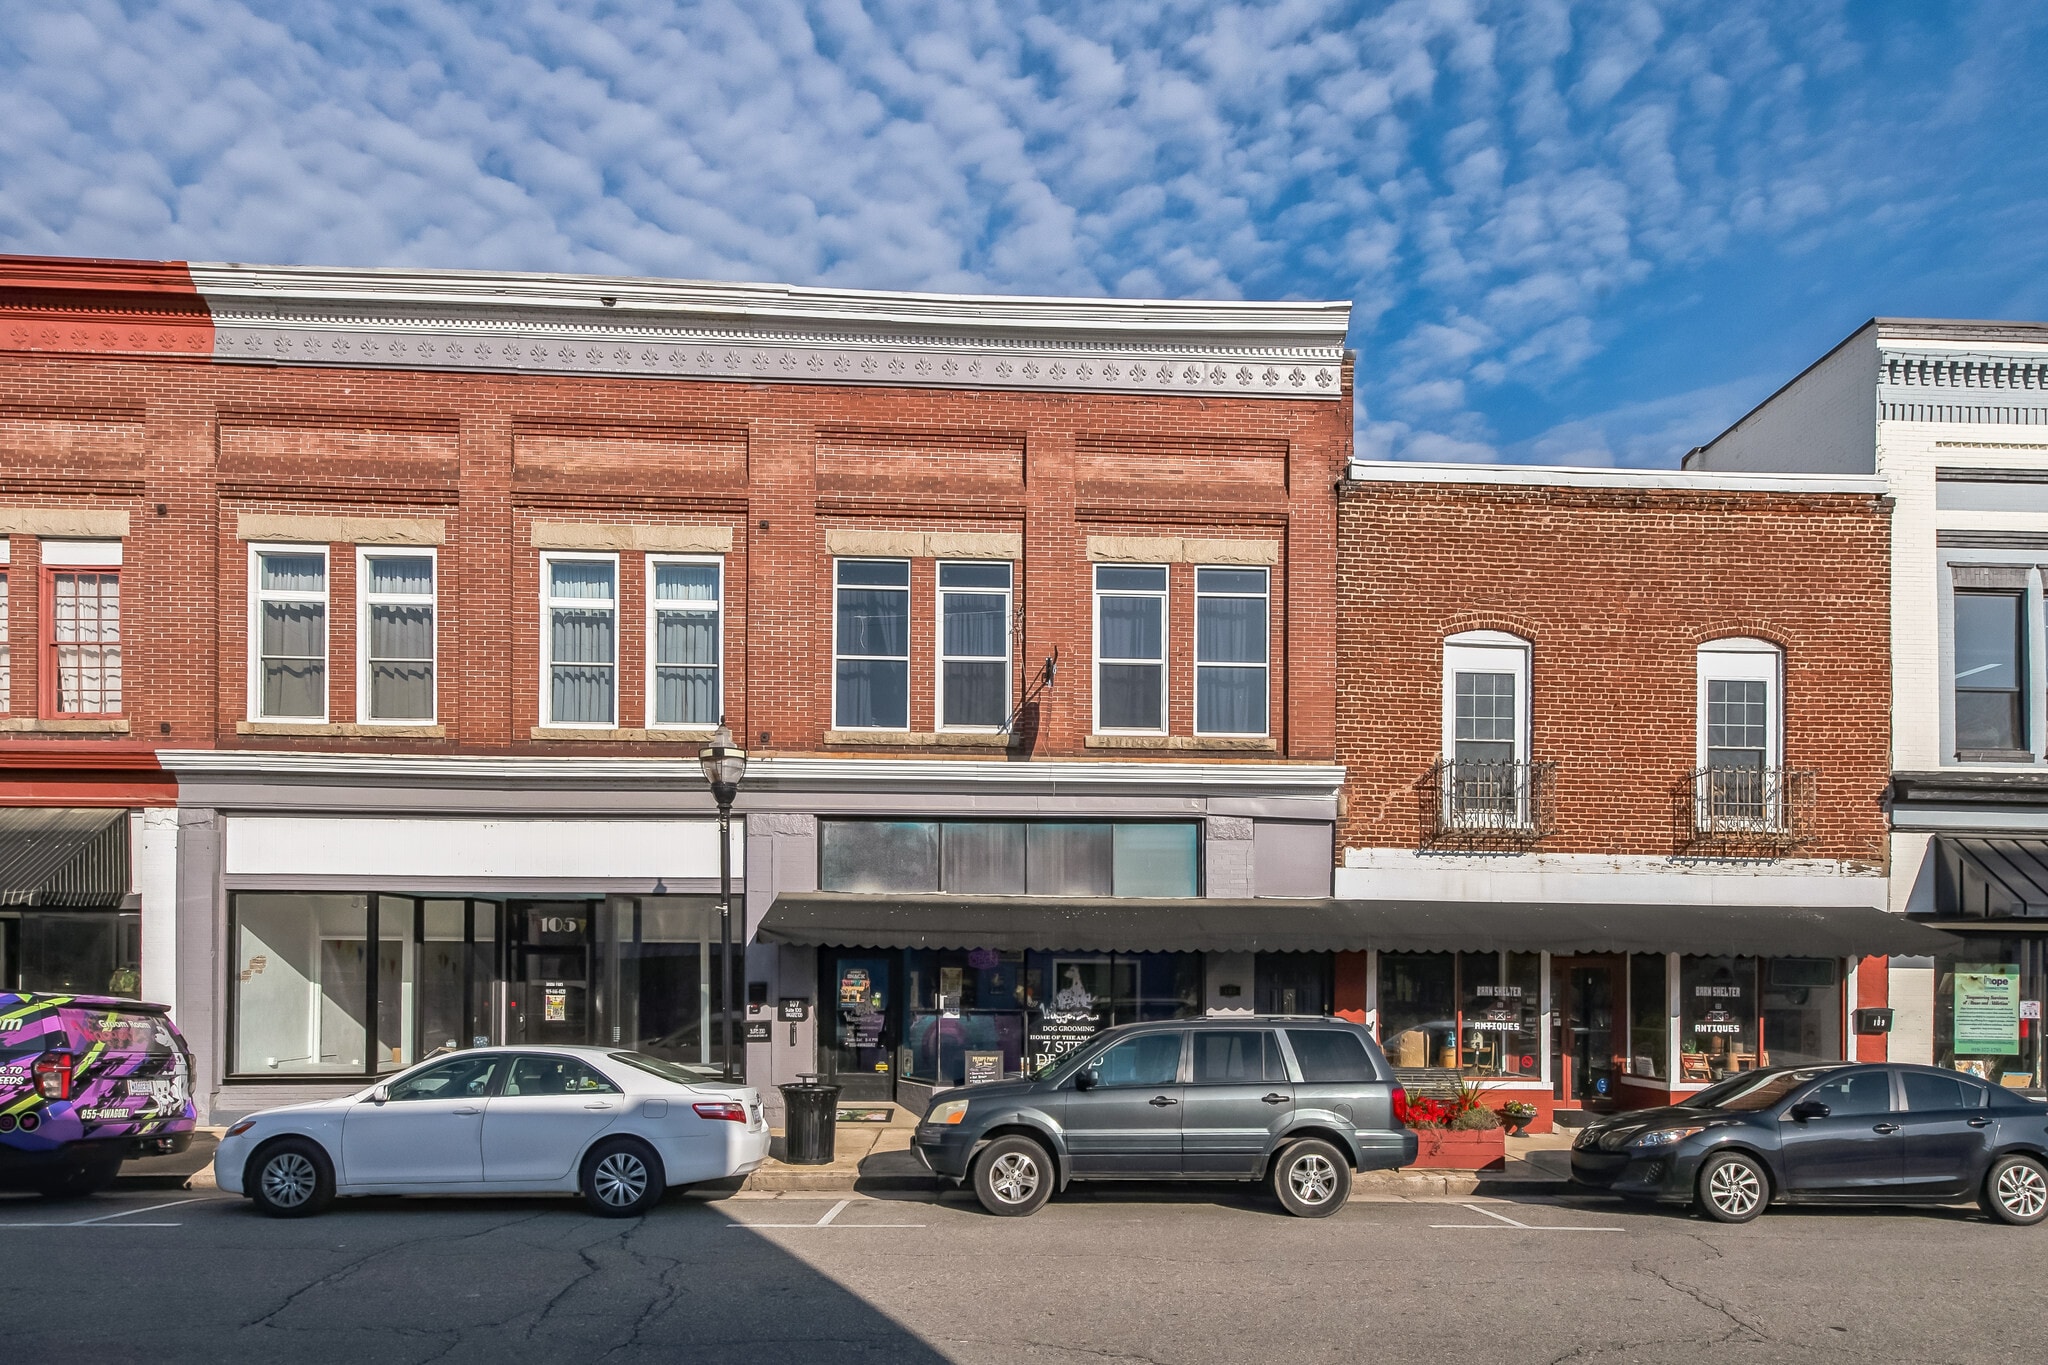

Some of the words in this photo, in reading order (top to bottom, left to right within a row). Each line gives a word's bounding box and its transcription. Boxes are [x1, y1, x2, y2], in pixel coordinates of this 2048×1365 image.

[540, 917, 577, 933] 105
[1476, 986, 1493, 996] BARN
[1494, 986, 1522, 997] SHELTER
[1695, 986, 1712, 997] BARN
[1712, 986, 1740, 997] SHELTER
[98, 1019, 129, 1028] Groom
[128, 1020, 151, 1029] Room
[1474, 1022, 1520, 1031] ANTIQUES
[1694, 1024, 1740, 1033] ANTIQUES
[1042, 1041, 1051, 1053] 7
[9, 1066, 23, 1074] TO
